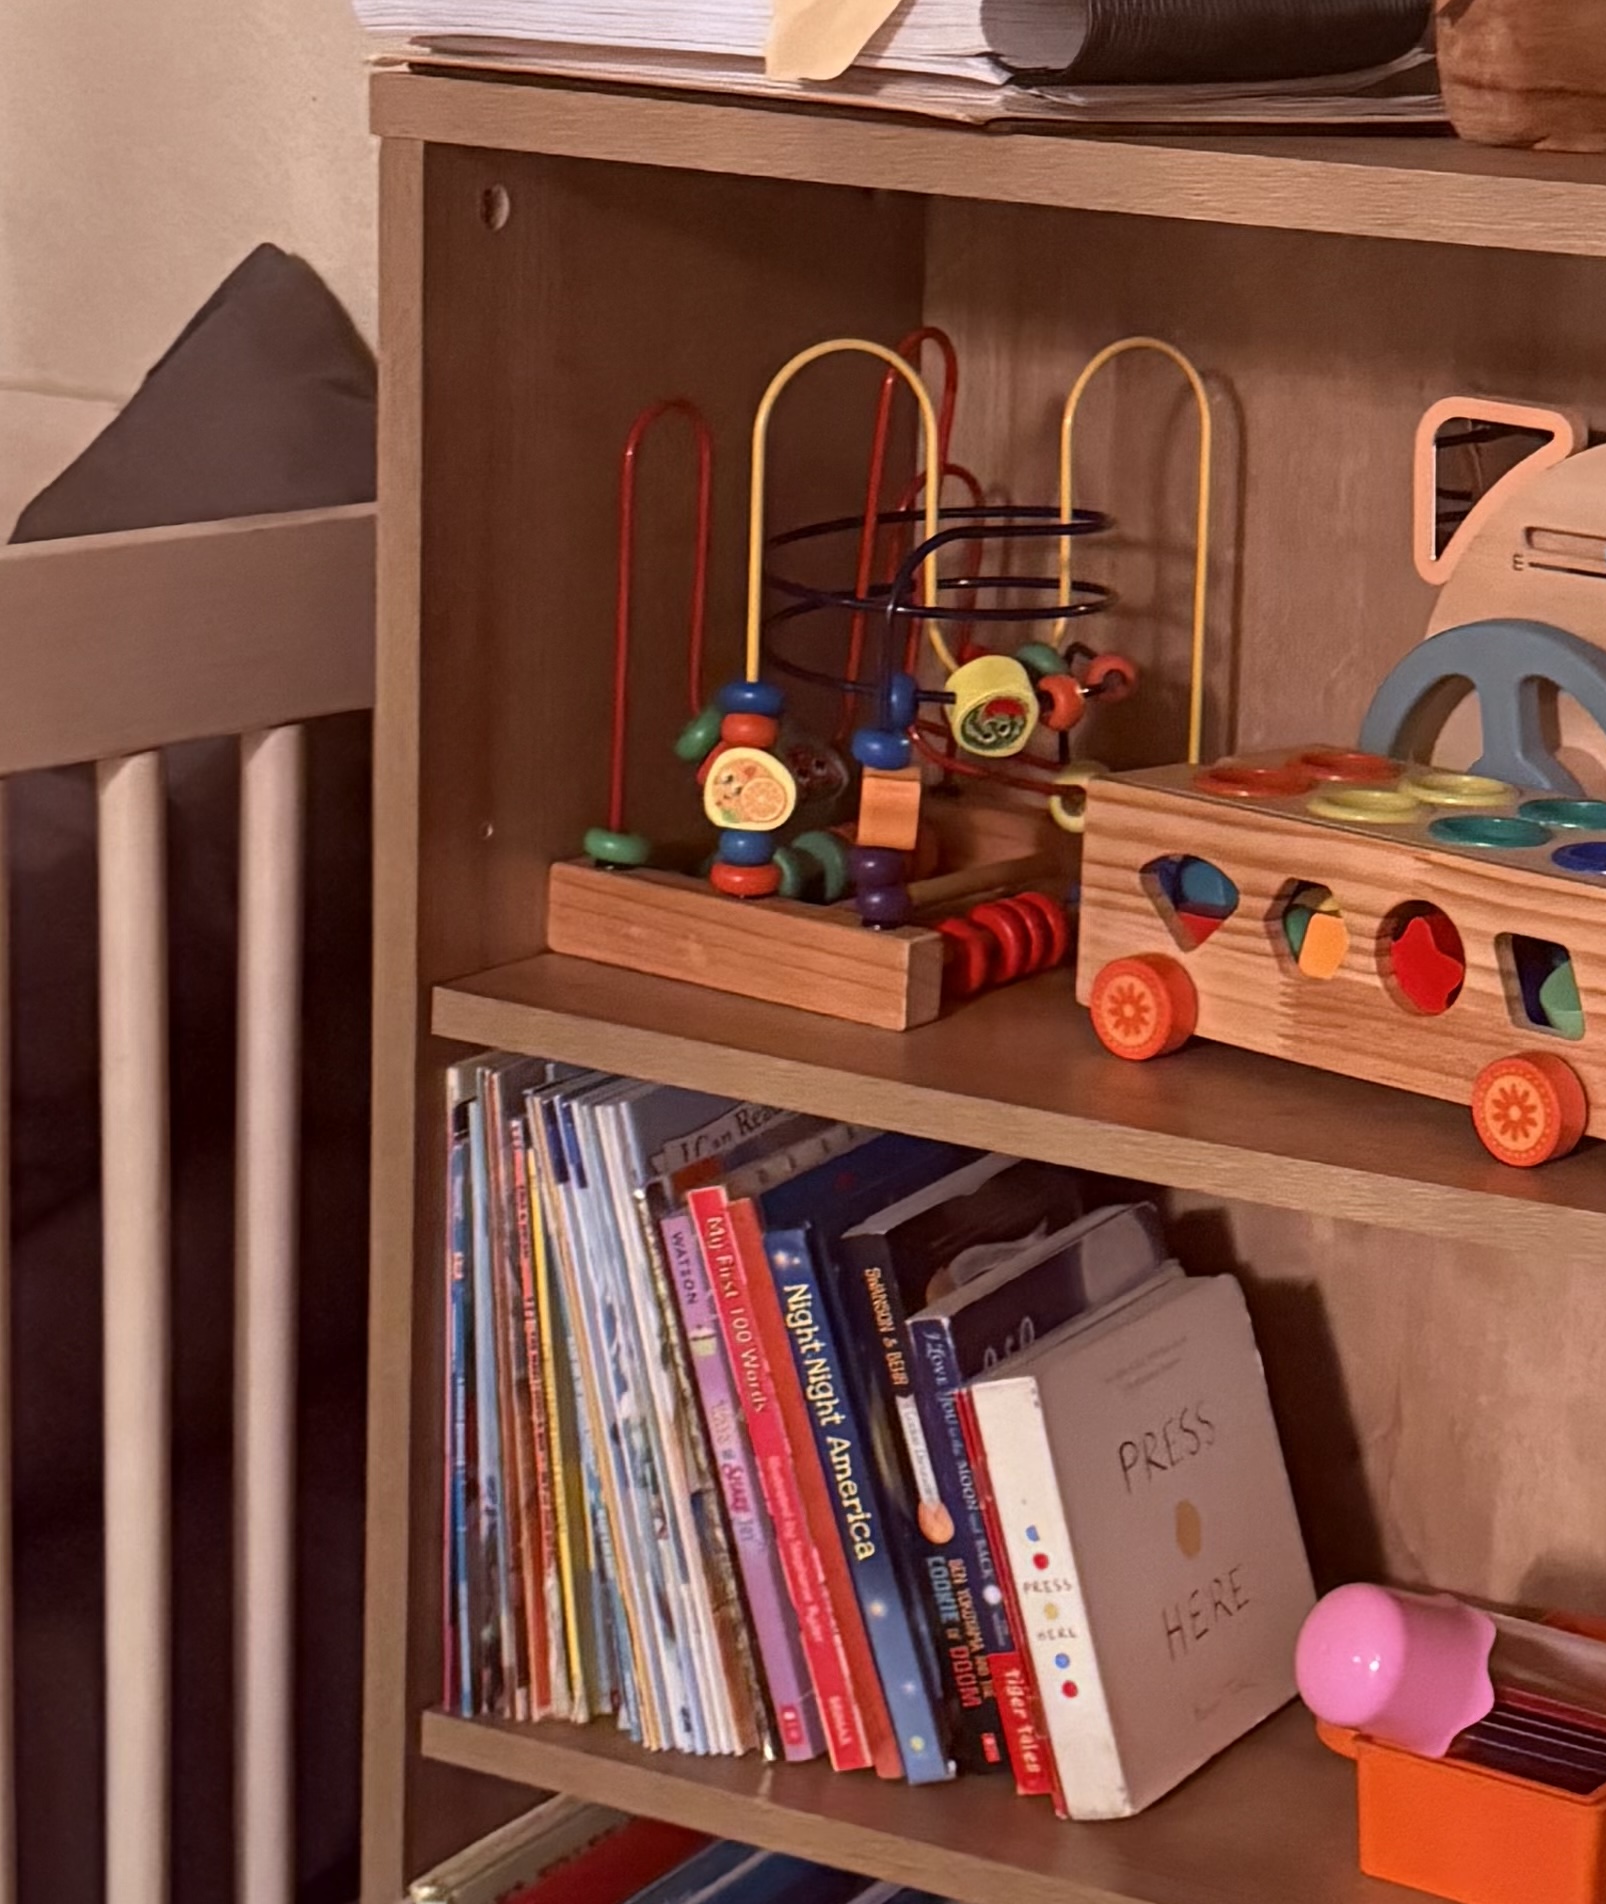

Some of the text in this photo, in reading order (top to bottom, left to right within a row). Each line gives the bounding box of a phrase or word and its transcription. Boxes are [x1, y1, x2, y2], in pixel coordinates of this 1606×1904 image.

[1512, 553, 1524, 571] E
[672, 1231, 699, 1306] WATSON
[705, 1216, 768, 1414] My First 100 Words
[864, 1267, 896, 1332] SWANSON
[885, 1350, 909, 1386] BEHR
[826, 1436, 876, 1562] America
[1117, 1402, 1216, 1494] PRESS
[955, 1458, 980, 1512] MOON
[975, 1539, 993, 1578] BACK
[948, 1558, 968, 1585] BEN
[1022, 1579, 1073, 1594] PRESS
[1161, 1563, 1251, 1662] HERE
[926, 1556, 960, 1623] COOKIE
[949, 1647, 983, 1709] DOOM
[1003, 1667, 1042, 1774] tiger tales
